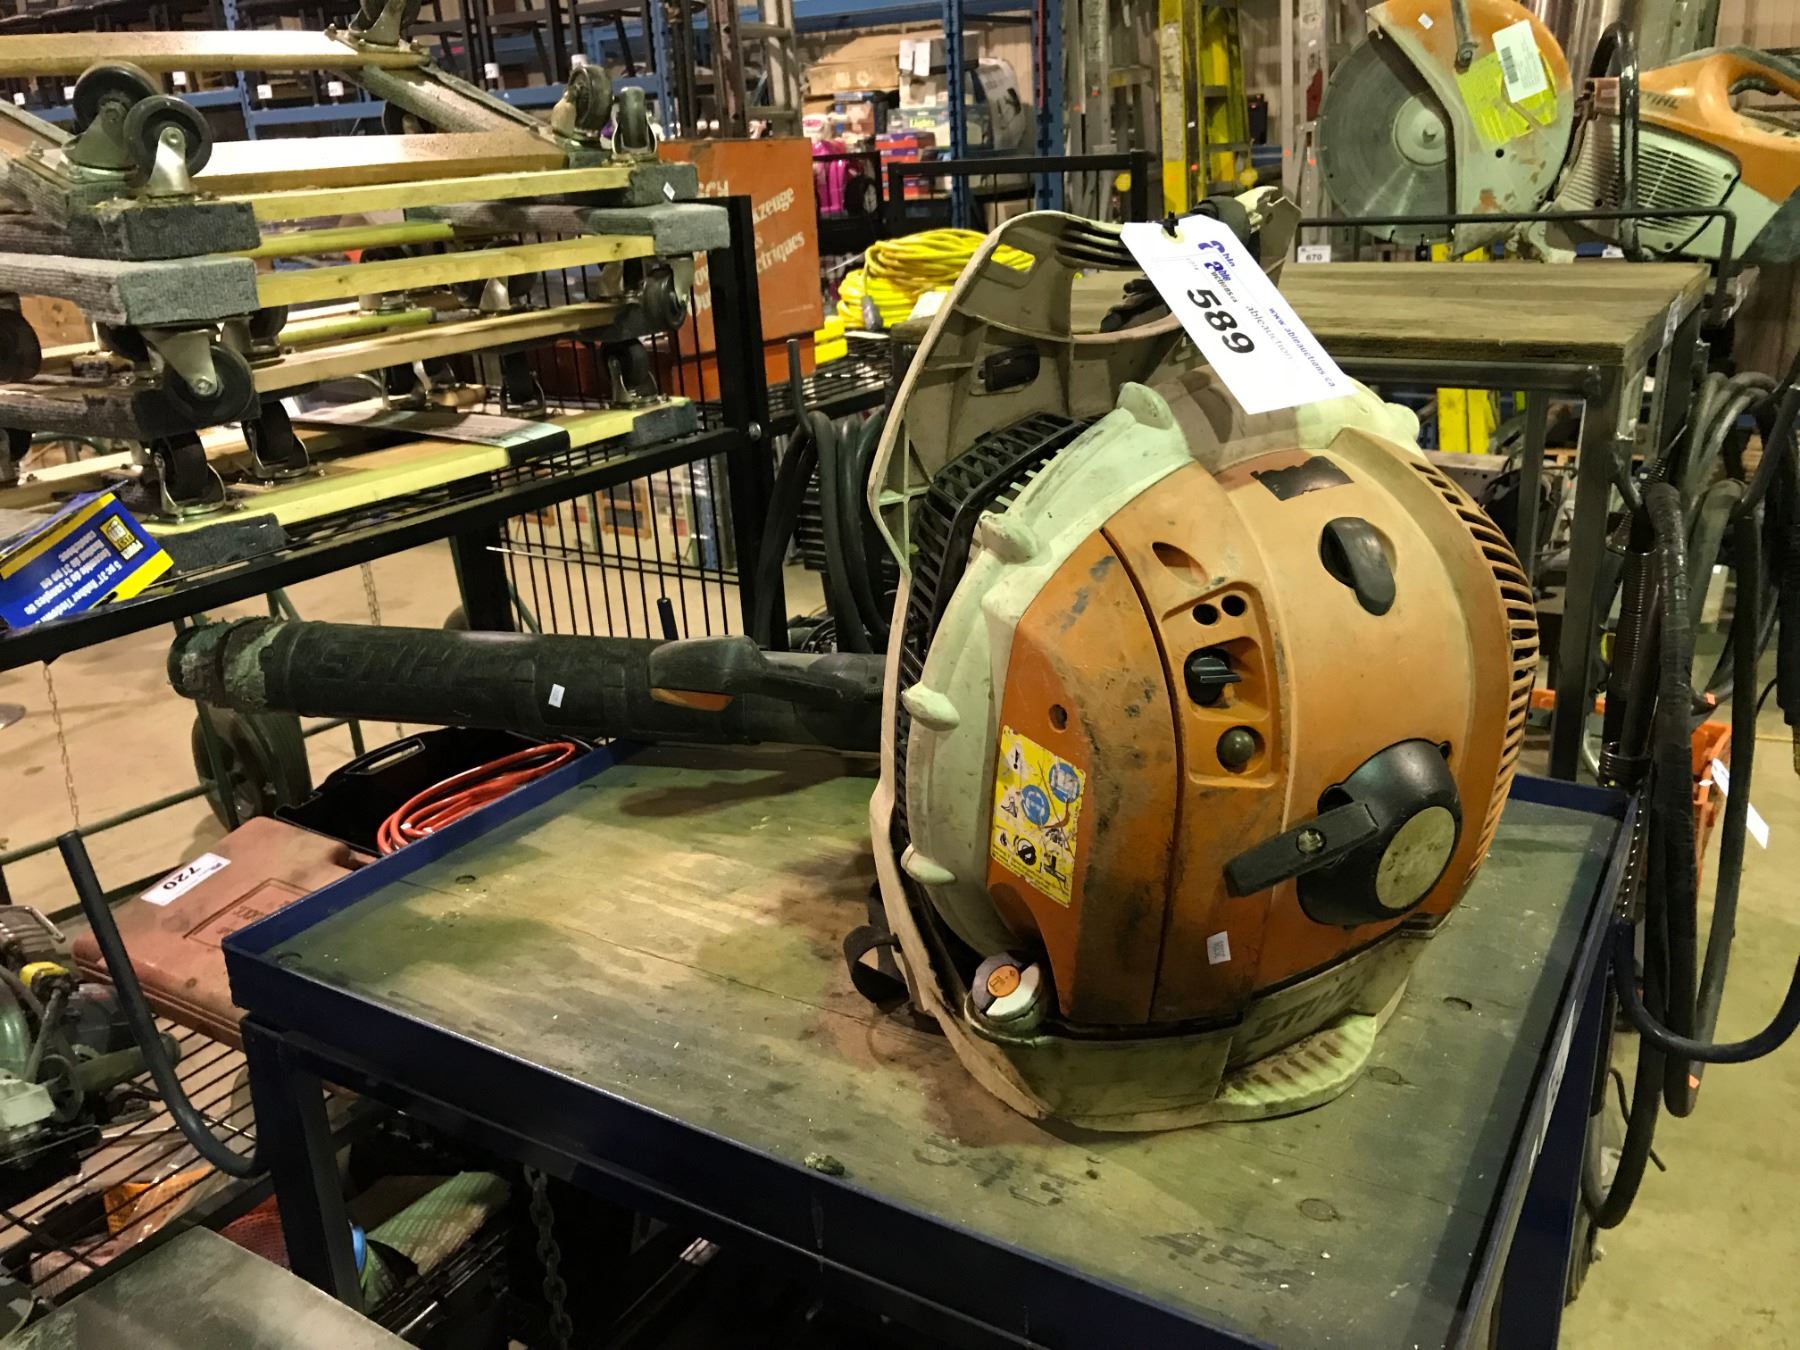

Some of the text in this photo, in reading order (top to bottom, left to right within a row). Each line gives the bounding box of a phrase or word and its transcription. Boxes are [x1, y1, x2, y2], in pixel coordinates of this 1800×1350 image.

[1305, 253, 1323, 262] 670
[1187, 288, 1255, 354] 589
[114, 560, 123, 570] 5
[64, 577, 74, 588] 5
[162, 866, 202, 890] 720
